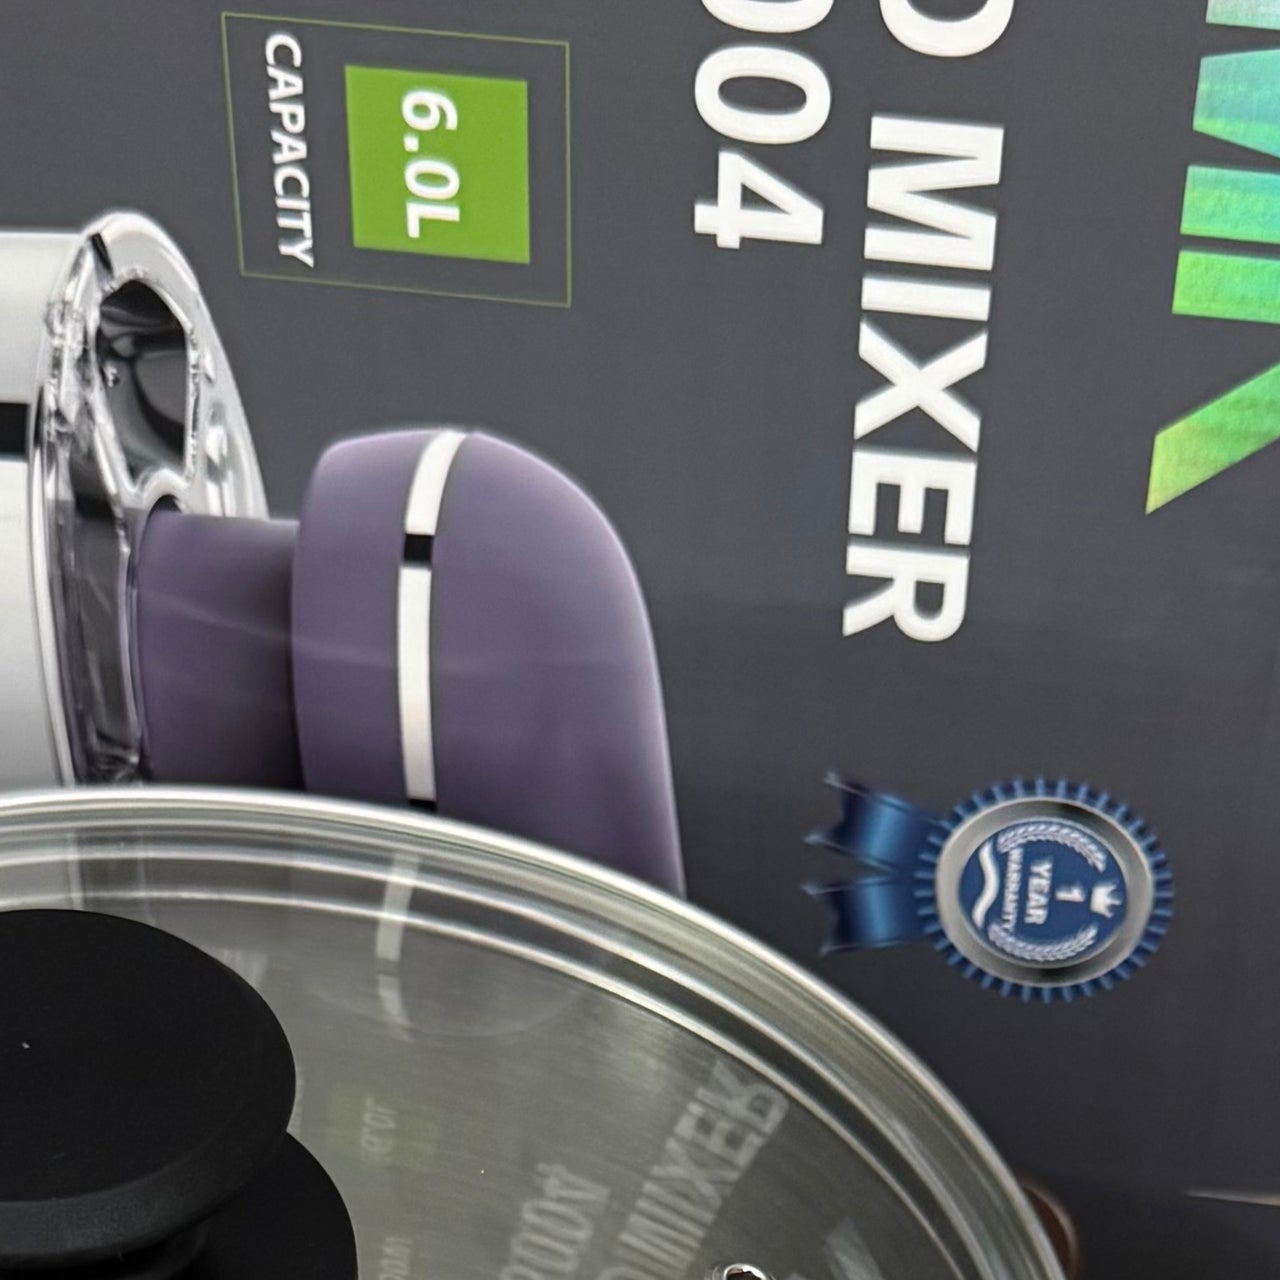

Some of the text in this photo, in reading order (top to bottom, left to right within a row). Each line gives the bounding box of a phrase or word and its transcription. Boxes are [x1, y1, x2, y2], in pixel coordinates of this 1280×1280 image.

[264, 32, 315, 269] CAPACITY
[400, 88, 461, 240] 6.0L
[841, 113, 1005, 644] MIXER
[1023, 857, 1054, 926] YEAR
[1055, 882, 1085, 904] 1
